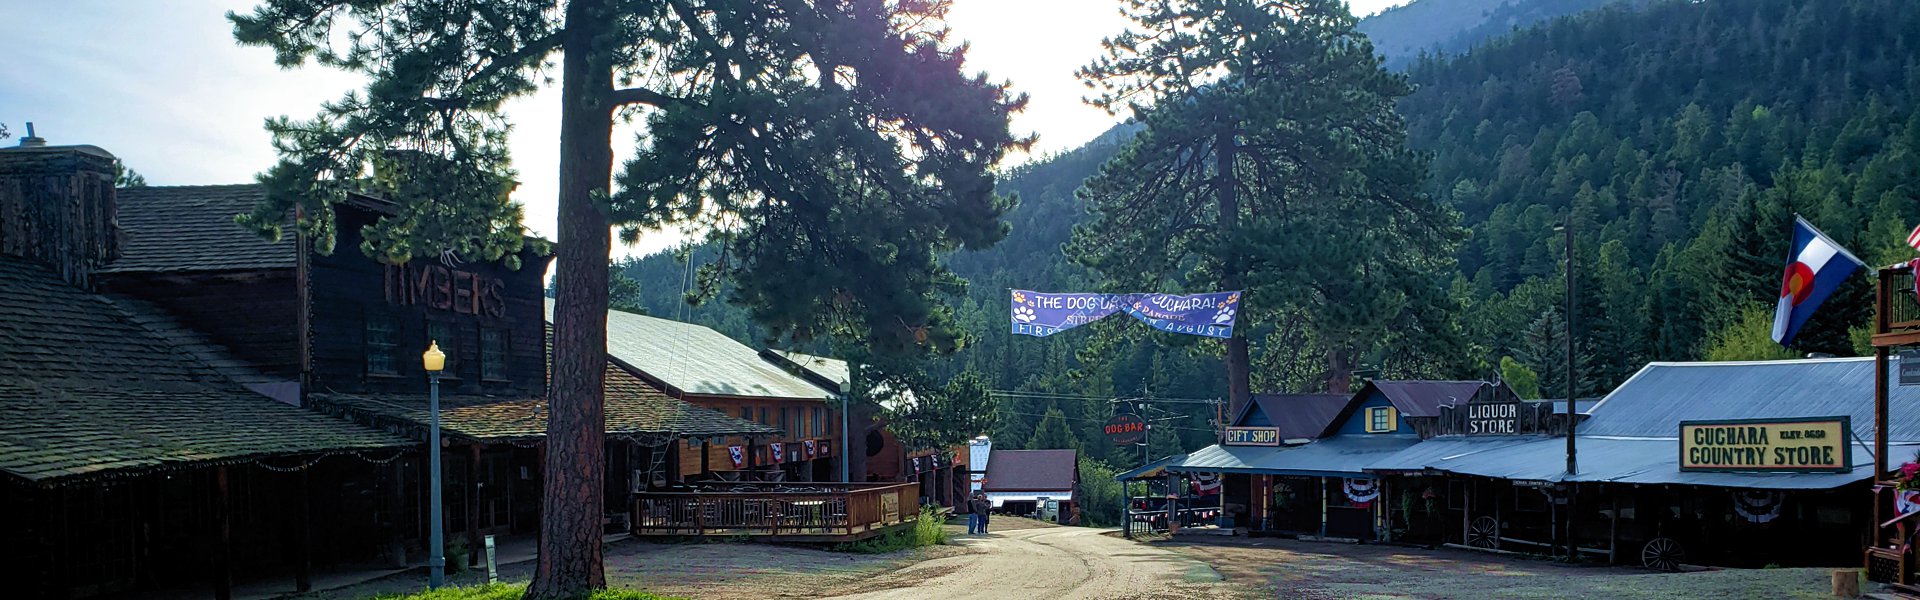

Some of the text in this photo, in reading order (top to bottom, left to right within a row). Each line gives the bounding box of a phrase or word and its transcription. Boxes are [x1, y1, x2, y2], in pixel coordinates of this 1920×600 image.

[383, 262, 506, 318] TIMBERS
[1035, 296, 1062, 309] THE
[1067, 296, 1096, 310] DOG
[1469, 404, 1517, 419] LIQUOR
[1105, 421, 1143, 434] DOG BAR
[1470, 419, 1515, 433] STORE
[1252, 430, 1276, 442] SHOP
[1694, 426, 1769, 446] CUCHARA
[1689, 445, 1834, 465] COUNTRY STORE
